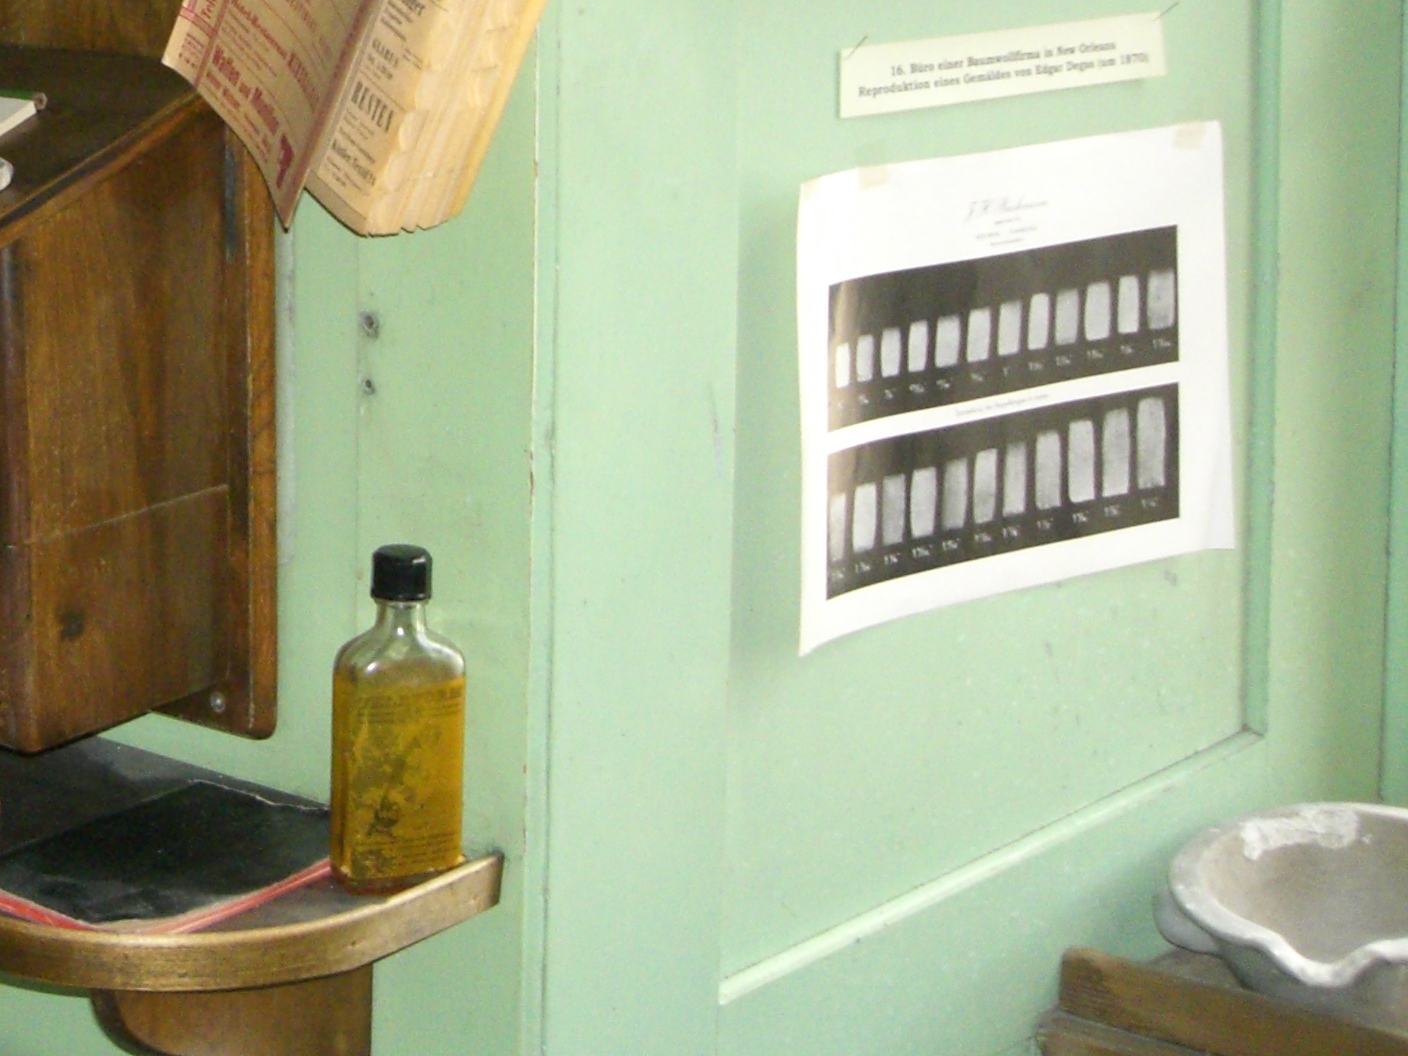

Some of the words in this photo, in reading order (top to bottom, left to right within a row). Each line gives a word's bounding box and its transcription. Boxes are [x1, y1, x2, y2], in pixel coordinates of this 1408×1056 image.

[891, 64, 906, 76] 16.
[910, 60, 935, 74] Büro
[937, 57, 964, 70] einer
[967, 47, 1041, 67] Baumwollfirma
[1044, 47, 1054, 59] in
[1056, 44, 1076, 56] New
[1078, 41, 1117, 54] Orleans
[858, 77, 931, 99] Reproduktion
[933, 74, 961, 89] eines
[963, 69, 1012, 86] Gemäldes
[1014, 67, 1033, 78] von
[1034, 63, 1064, 78] Edgar
[1066, 59, 1096, 74] Degas
